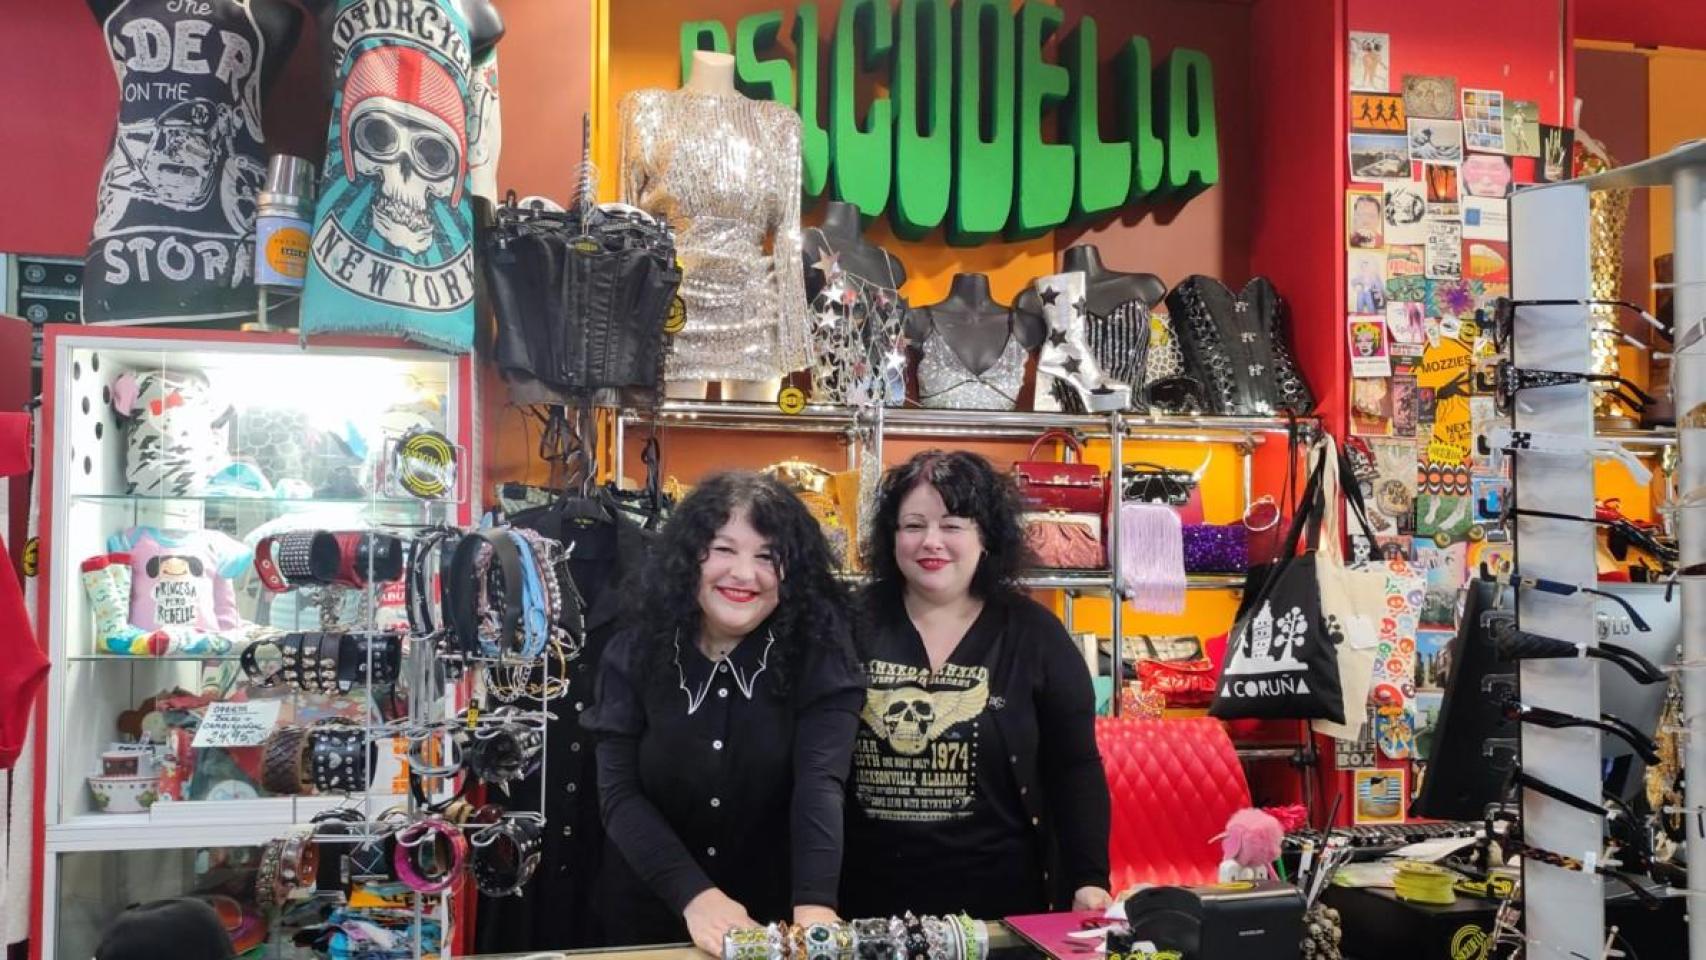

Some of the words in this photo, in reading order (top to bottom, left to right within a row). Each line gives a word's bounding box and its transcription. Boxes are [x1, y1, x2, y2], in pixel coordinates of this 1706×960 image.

[113, 18, 251, 100] DER
[125, 83, 150, 102] ON
[152, 82, 192, 101] THE
[317, 226, 393, 297] NEW
[1422, 354, 1471, 373] MOZZIES
[1233, 673, 1311, 698] CORUÑA
[931, 742, 968, 770] 1974
[1336, 753, 1375, 766] BOX
[921, 772, 968, 786] ALABAMA
